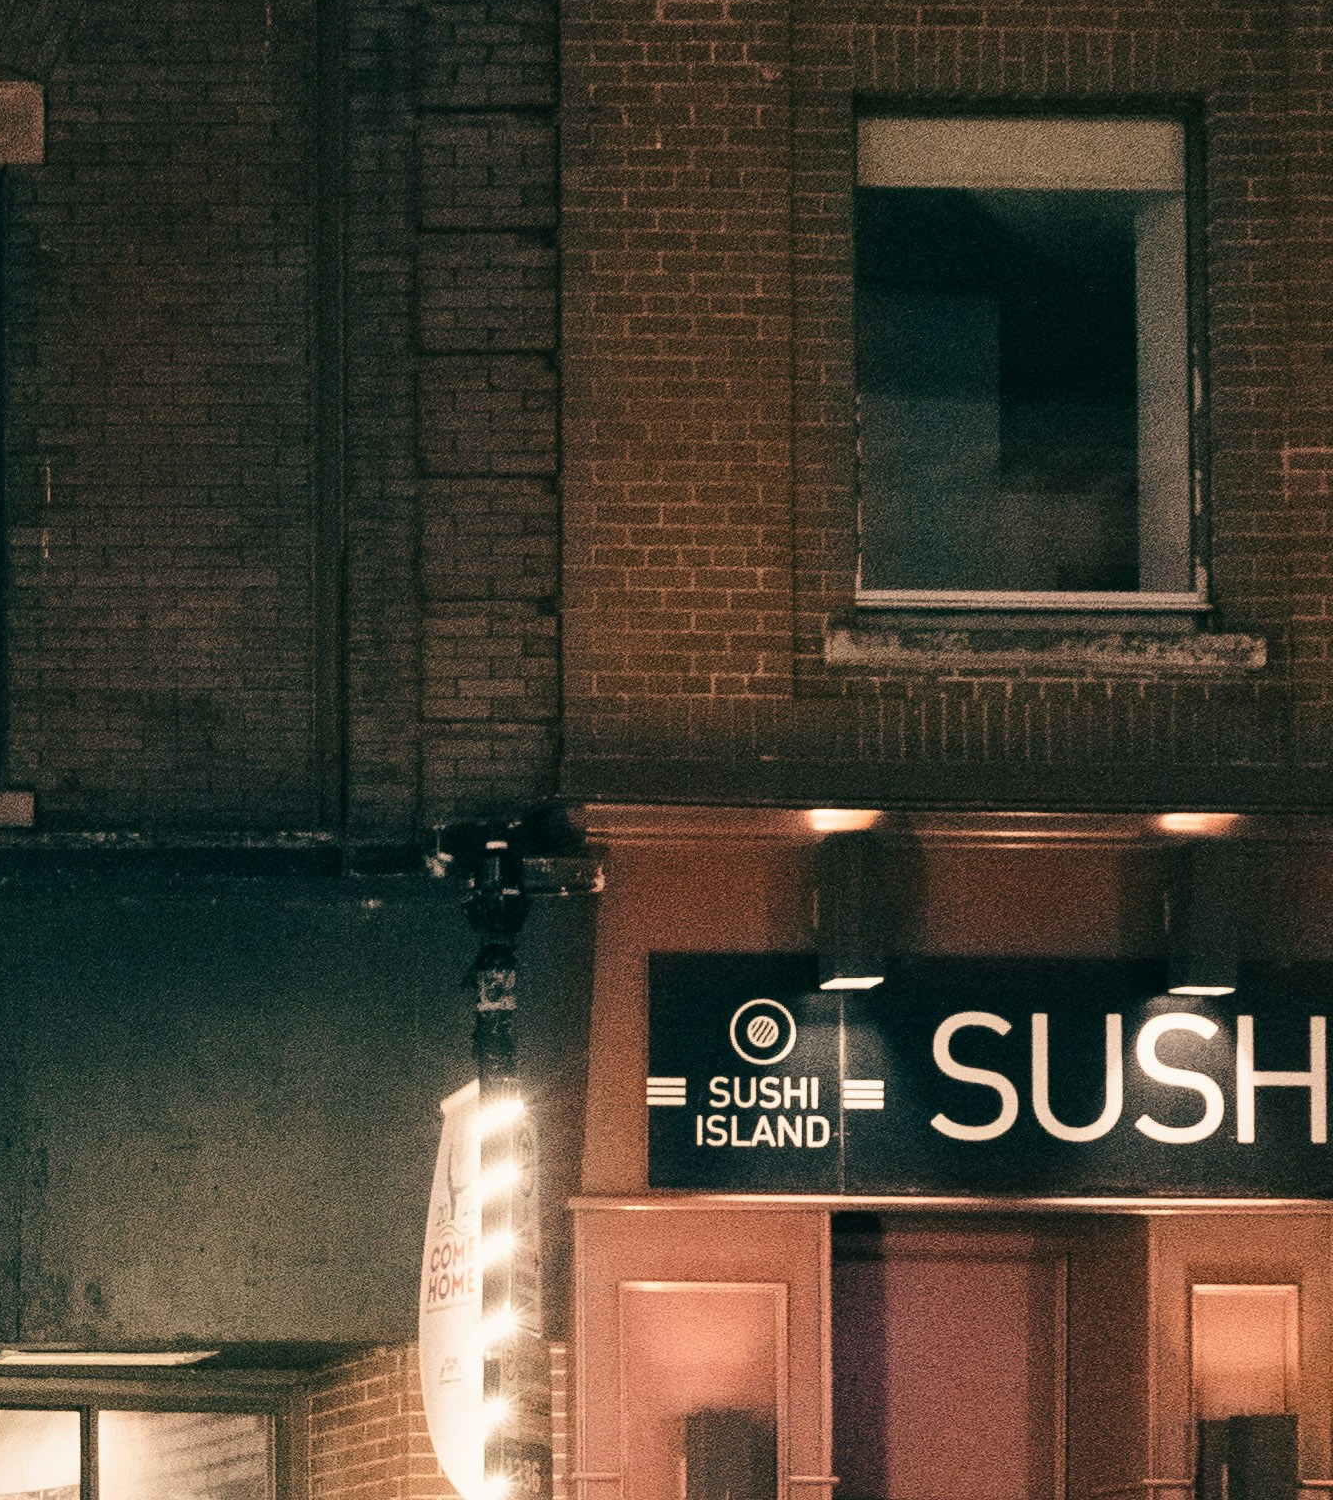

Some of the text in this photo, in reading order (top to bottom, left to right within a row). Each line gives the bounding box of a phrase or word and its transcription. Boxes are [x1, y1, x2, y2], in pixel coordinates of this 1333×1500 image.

[709, 1076, 820, 1109] SUSHI
[696, 1115, 831, 1149] ISLAND
[429, 1236, 475, 1274] COME
[427, 1269, 475, 1304] HOME
